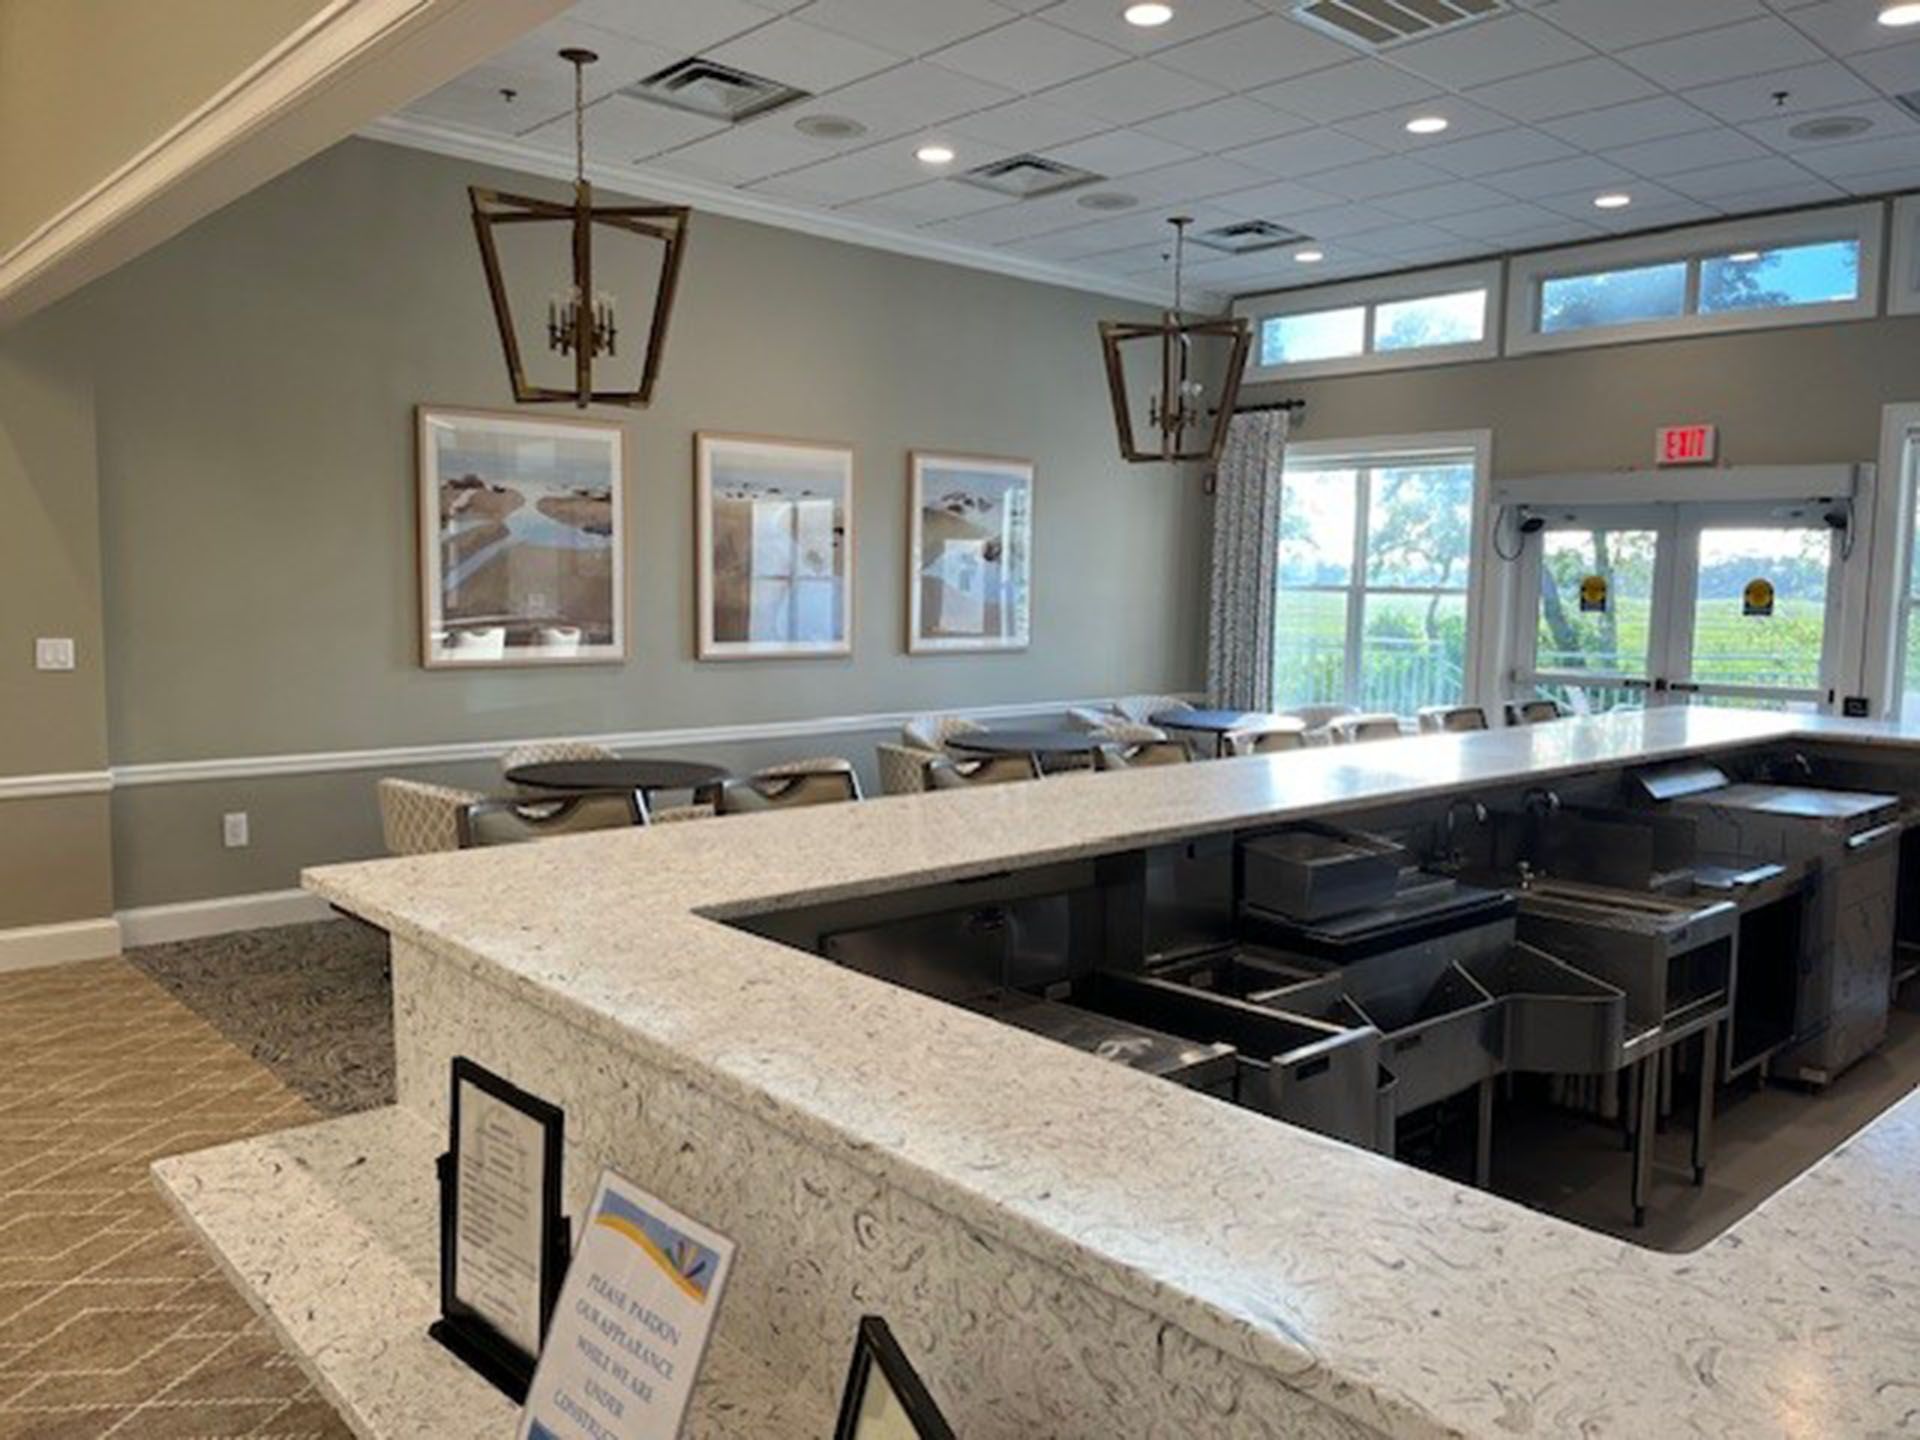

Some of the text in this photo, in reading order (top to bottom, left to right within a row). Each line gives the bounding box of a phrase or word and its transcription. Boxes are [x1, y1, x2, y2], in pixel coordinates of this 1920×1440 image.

[1665, 429, 1706, 459] EXIT
[587, 1273, 682, 1346] PLEASE PARDON
[576, 1298, 674, 1381] OUR APPEARANCE
[584, 1377, 625, 1418] UNDER
[611, 1360, 630, 1385] WE
[632, 1376, 653, 1404] ARE
